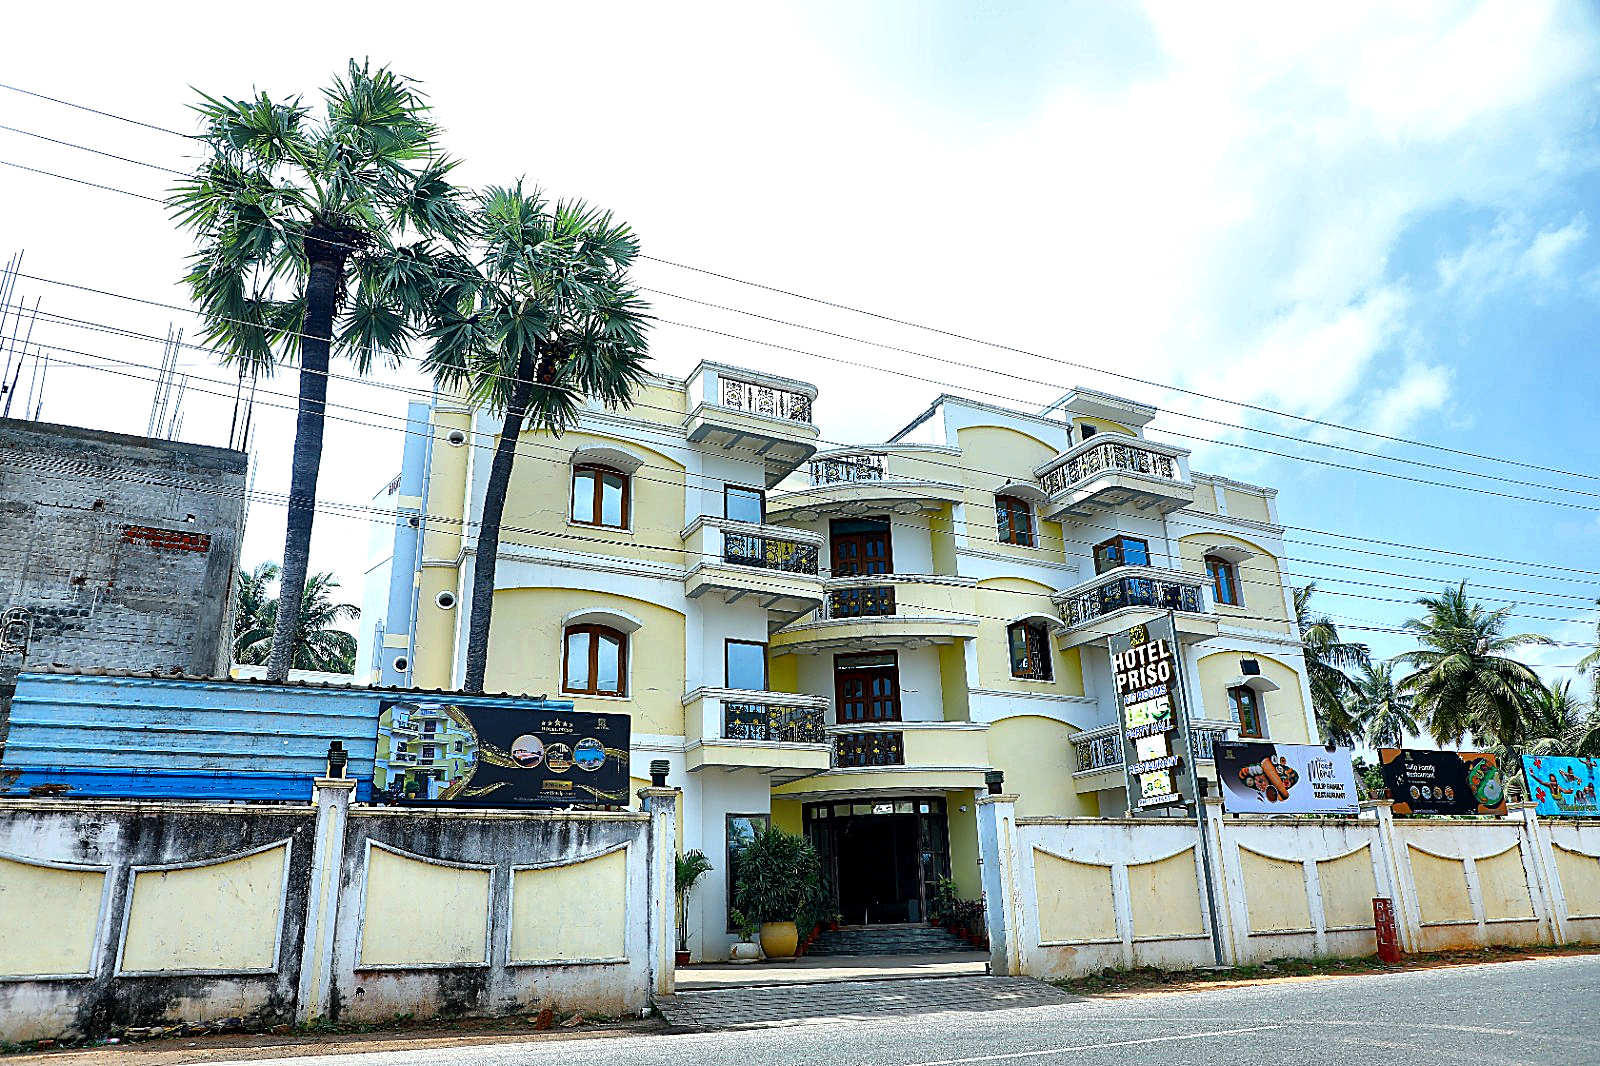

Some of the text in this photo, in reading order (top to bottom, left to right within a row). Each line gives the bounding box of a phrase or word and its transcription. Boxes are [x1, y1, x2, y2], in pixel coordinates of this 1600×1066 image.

[1112, 638, 1170, 673] HOTEL
[1117, 660, 1170, 694] PRISO
[1137, 684, 1167, 699] ROOMS
[1126, 724, 1150, 739] PARTY
[1128, 755, 1179, 774] RESTAURANT
[1313, 791, 1346, 799] RESTAURANT
